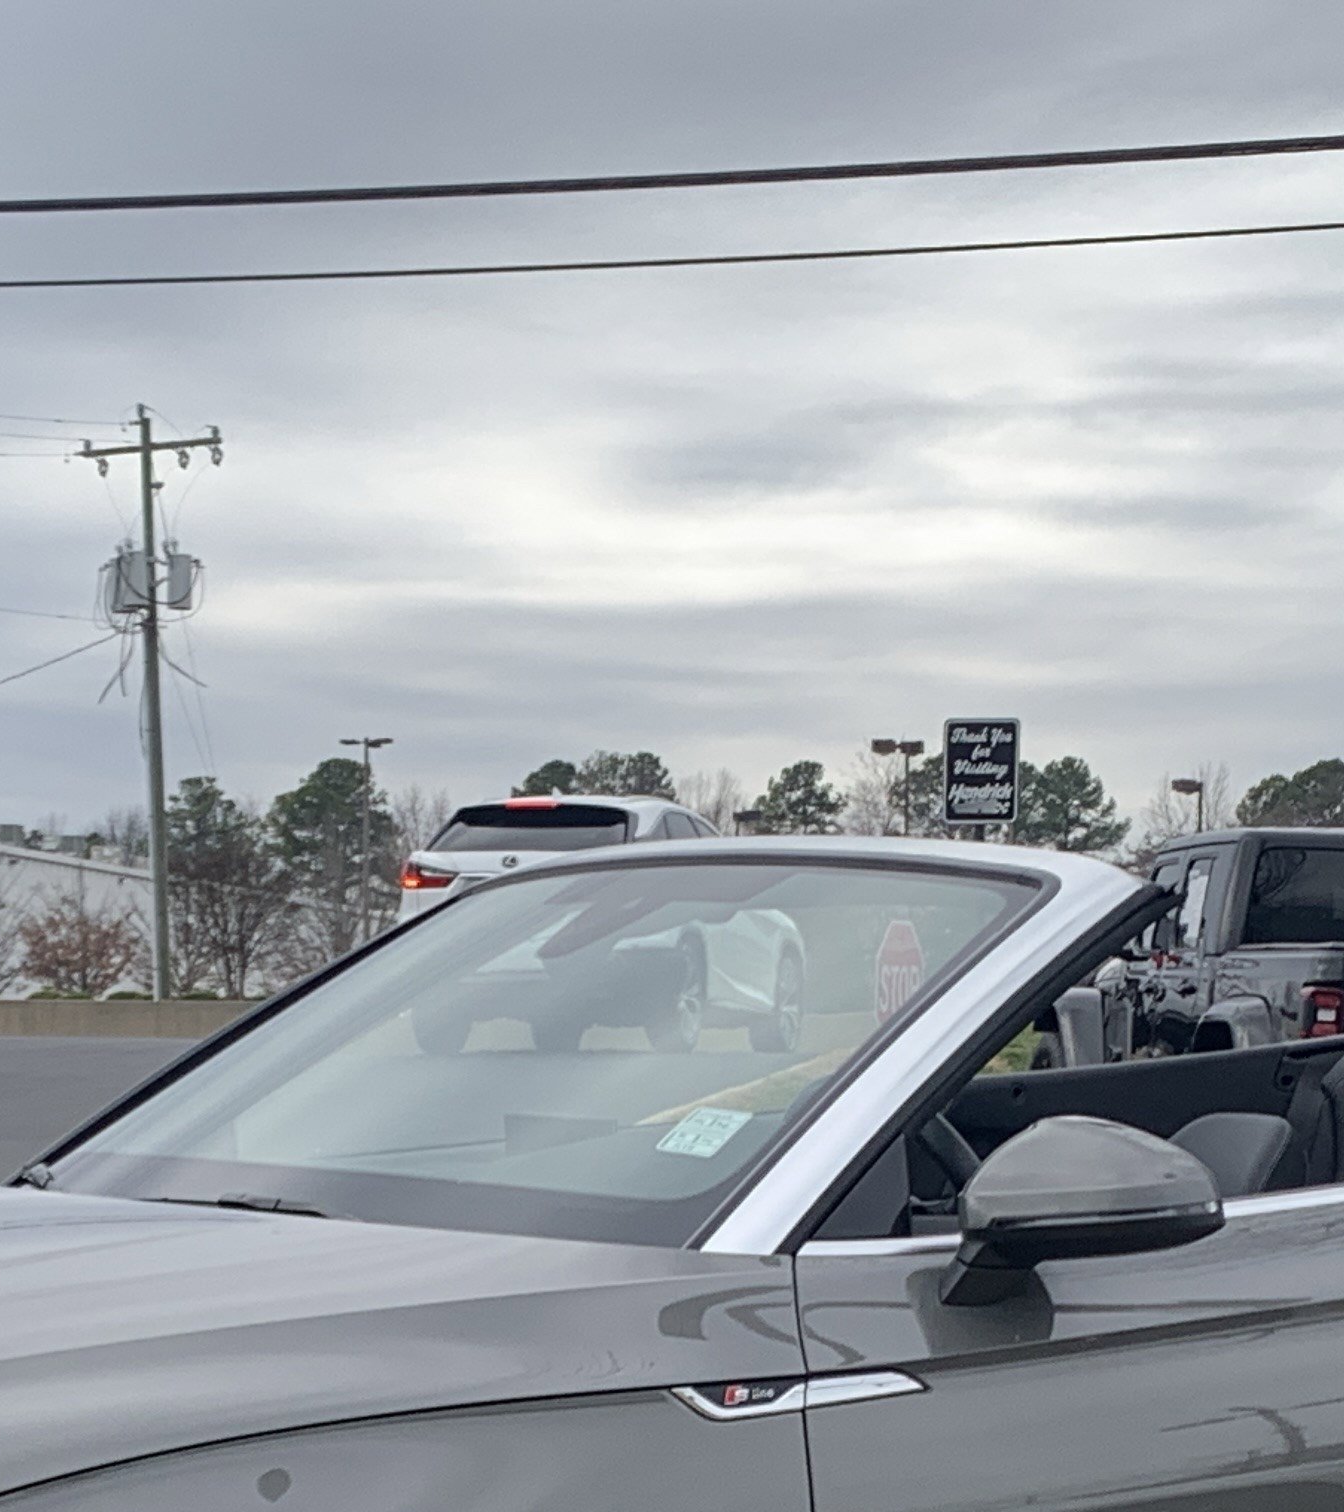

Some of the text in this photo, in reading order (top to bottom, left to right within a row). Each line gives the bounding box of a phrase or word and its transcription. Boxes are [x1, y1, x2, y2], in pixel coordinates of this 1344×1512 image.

[950, 726, 1013, 748] Thank You
[971, 744, 991, 760] for
[954, 759, 1009, 780] Visiting
[948, 782, 1013, 804] Hendrick
[879, 964, 920, 1013] STOP
